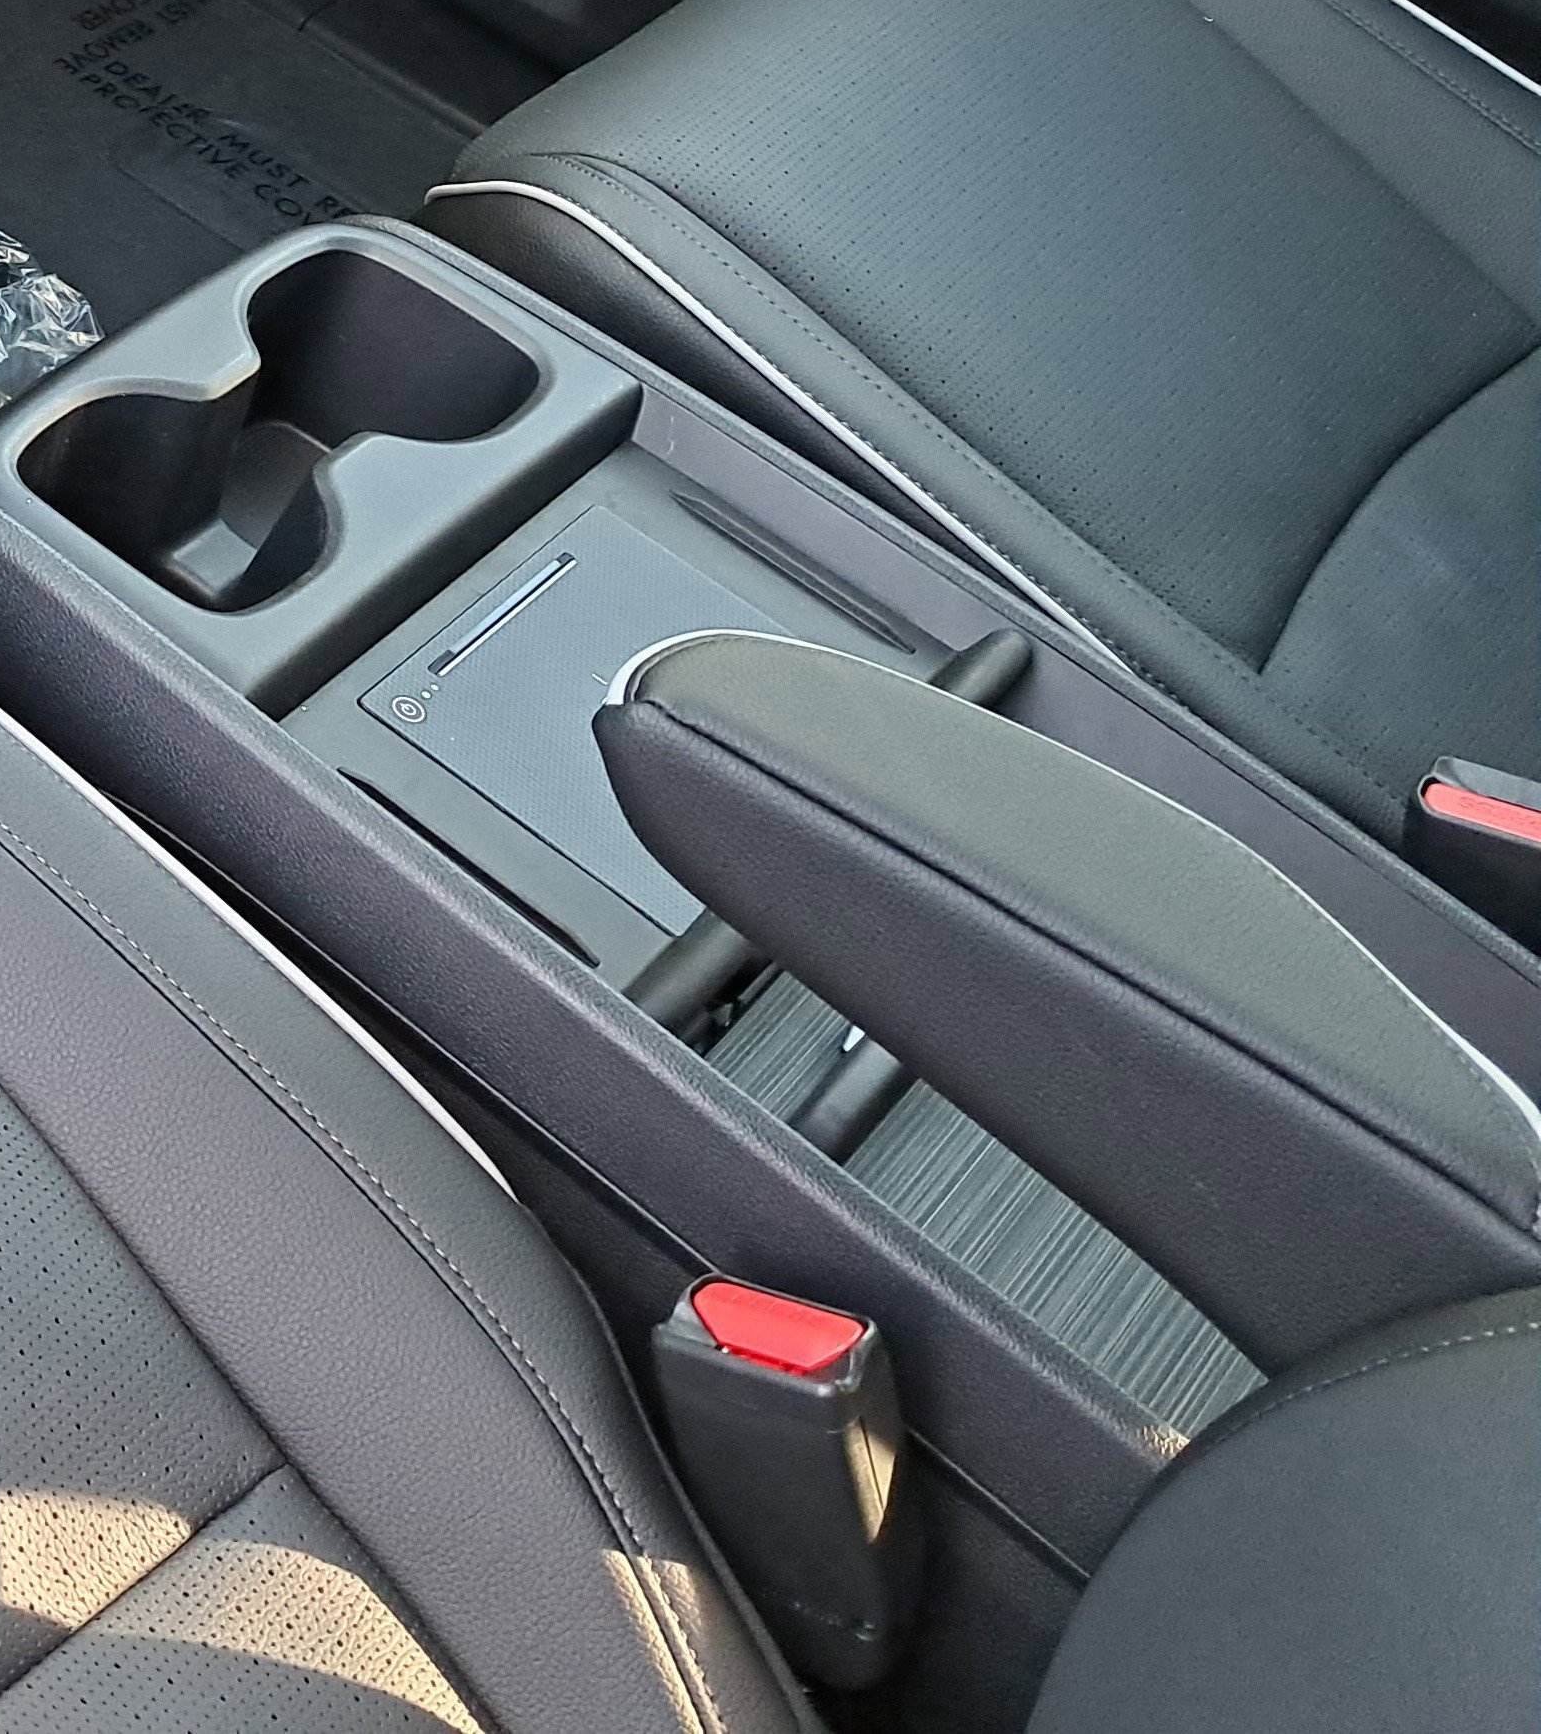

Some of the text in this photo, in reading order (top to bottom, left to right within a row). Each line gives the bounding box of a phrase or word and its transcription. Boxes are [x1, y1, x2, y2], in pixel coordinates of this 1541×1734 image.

[79, 73, 249, 180] PROTECTIVE
[105, 61, 310, 188] DEALER MUST
